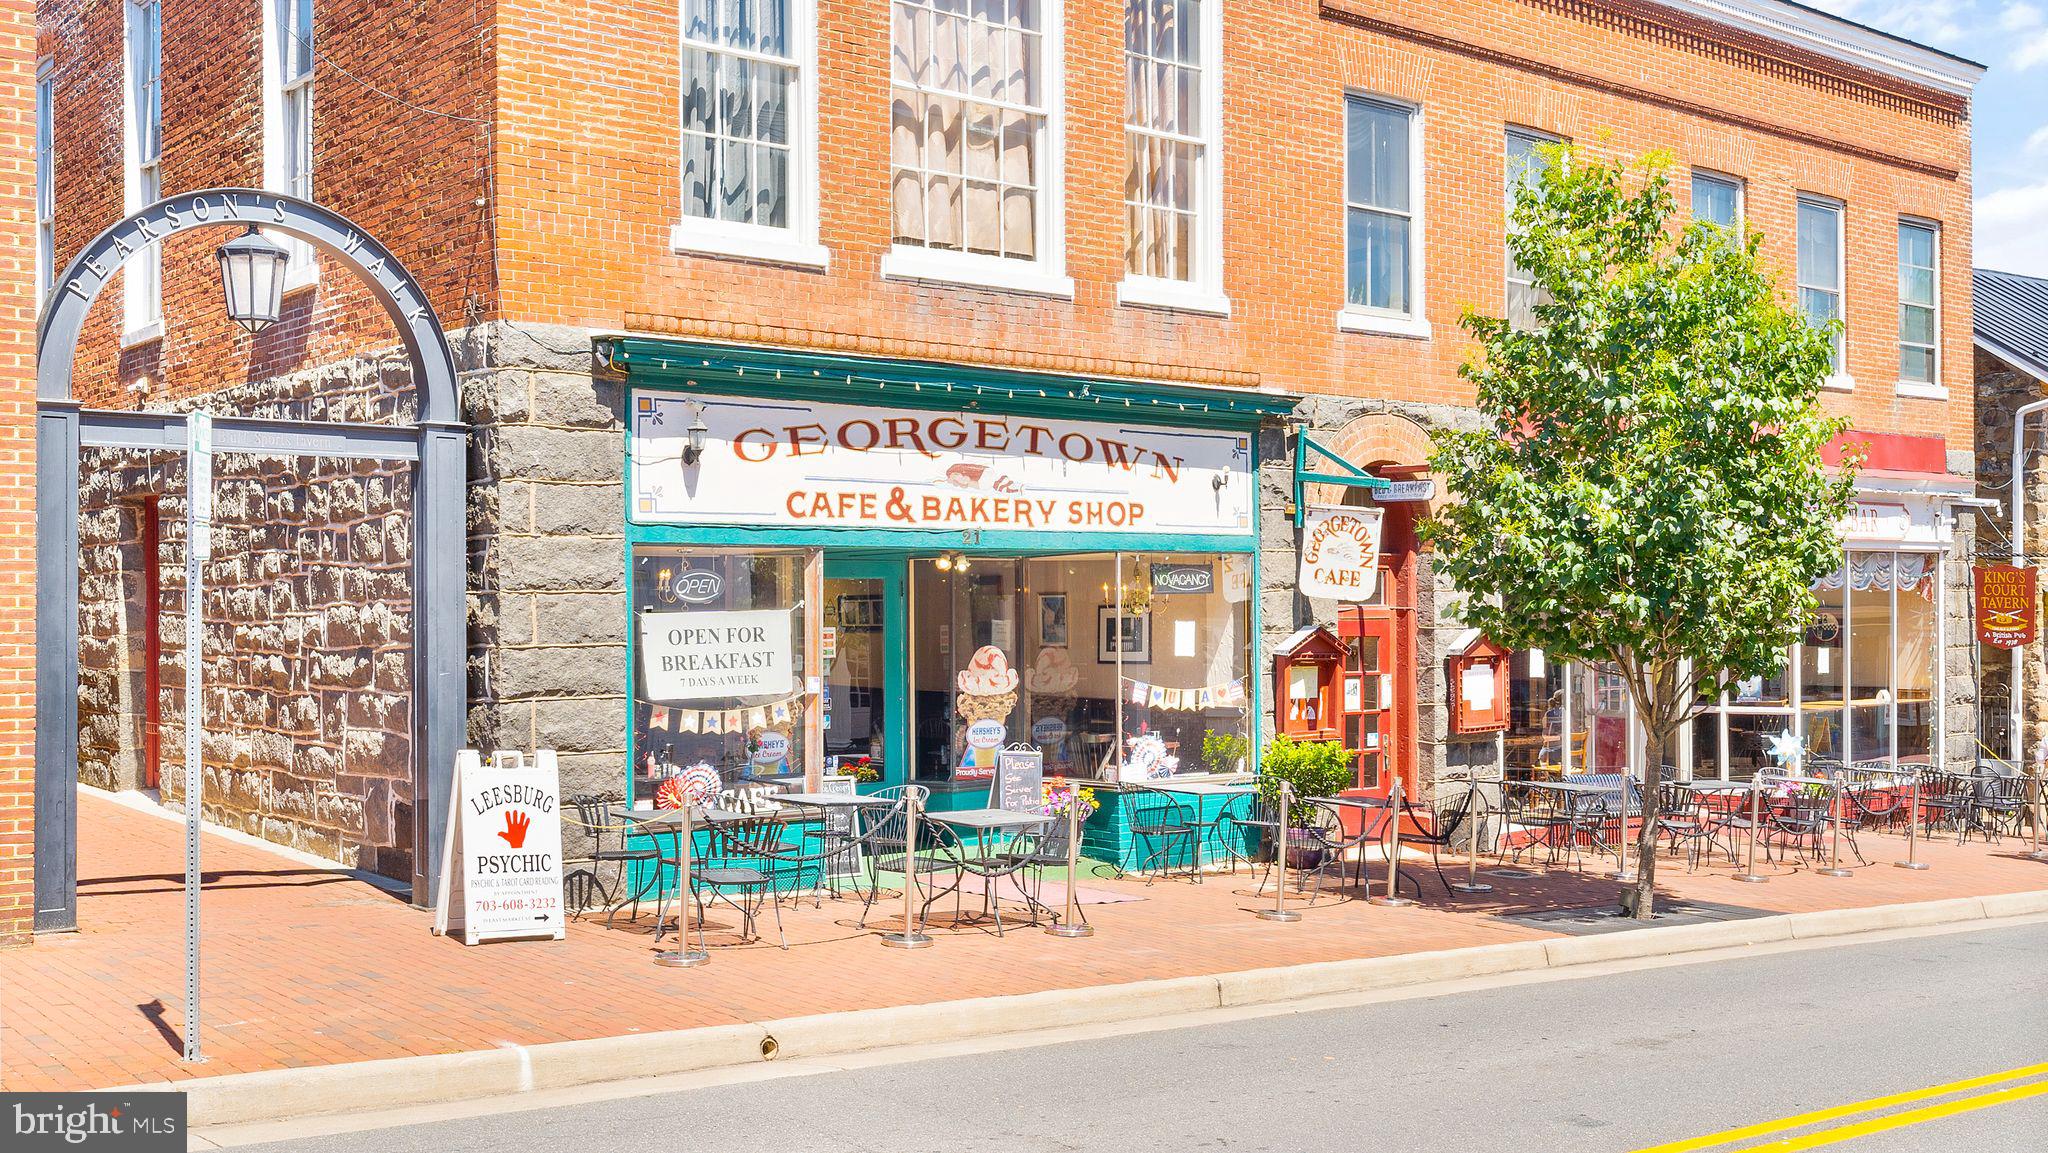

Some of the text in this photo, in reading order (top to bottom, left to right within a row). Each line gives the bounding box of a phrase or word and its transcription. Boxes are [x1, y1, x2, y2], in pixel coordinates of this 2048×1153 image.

[66, 193, 430, 329] PEARSON'S WALK
[733, 417, 1184, 484] GEORGETOWN
[786, 486, 1145, 527] CAFE & BAKERY SHOP
[961, 530, 980, 545] 21
[1305, 515, 1374, 569] GEORGETOWN
[1313, 568, 1361, 587] CAFE
[1983, 570, 2026, 584] KING'S
[676, 579, 721, 594] OPEN
[1983, 584, 2026, 596] COURT
[1981, 597, 2029, 609] TAVERN
[668, 626, 765, 646] OPEN FOR
[661, 651, 774, 671] BREAKFAST
[680, 675, 759, 687] 7 DAYS A WEEK
[1004, 757, 1035, 770] Please
[955, 769, 978, 777] Proudly
[1004, 774, 1022, 784] See
[471, 784, 554, 816] LEESBURG
[477, 854, 552, 874] PSYCHIC
[471, 878, 495, 888] PSYCHIC
[501, 877, 518, 887] TAROT
[519, 877, 534, 886] CARD
[535, 876, 559, 886] READING
[475, 897, 556, 912] 703-608-3232
